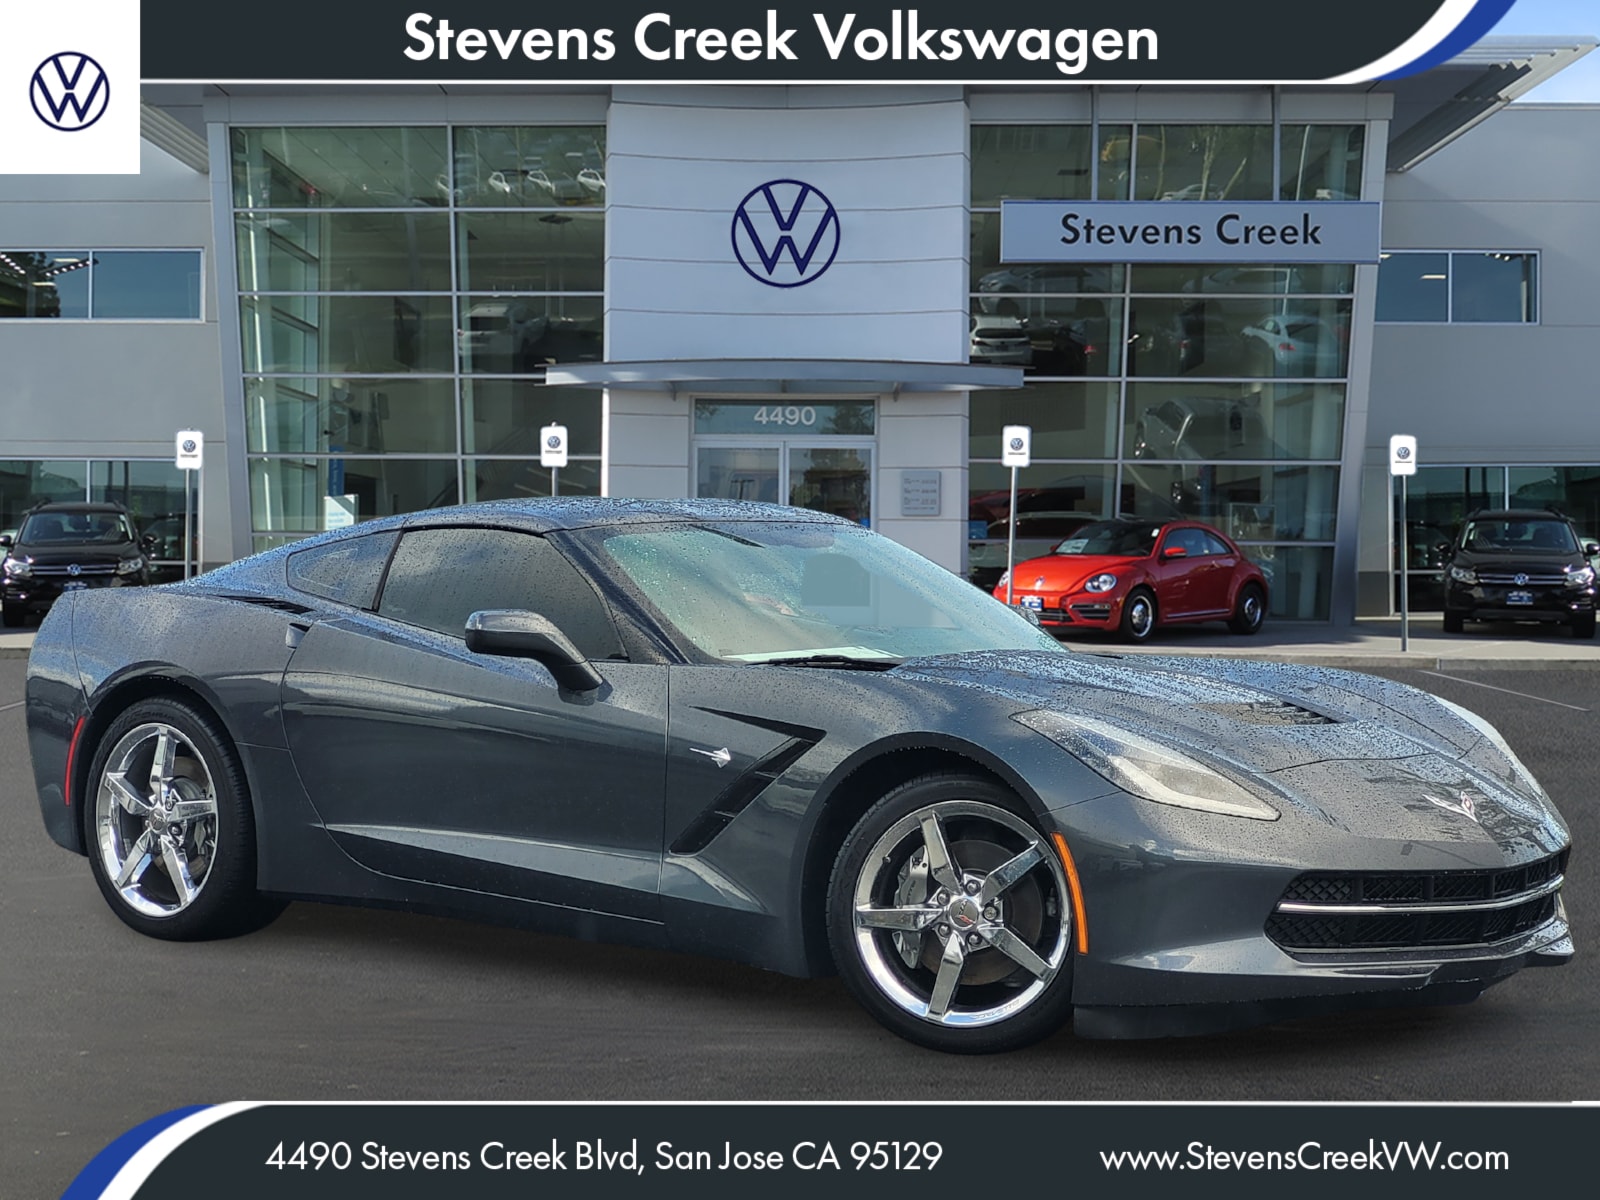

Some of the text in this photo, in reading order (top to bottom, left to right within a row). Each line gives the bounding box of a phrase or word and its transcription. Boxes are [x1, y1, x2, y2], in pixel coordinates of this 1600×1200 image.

[1060, 212, 1321, 246] Stevens Creek
[753, 406, 816, 426] 4490
